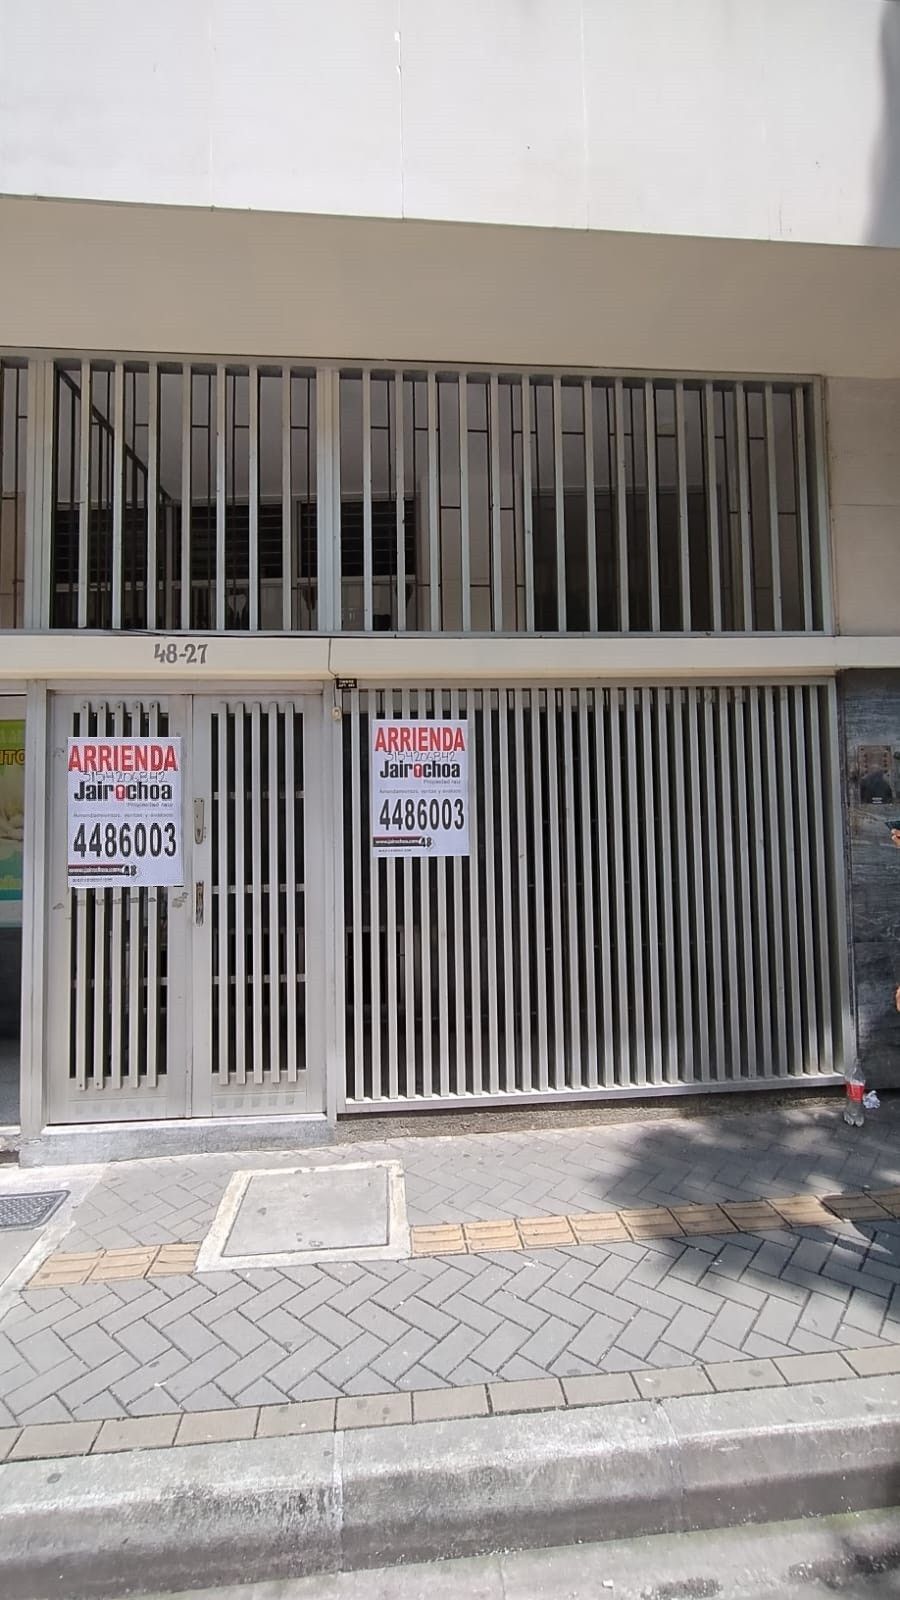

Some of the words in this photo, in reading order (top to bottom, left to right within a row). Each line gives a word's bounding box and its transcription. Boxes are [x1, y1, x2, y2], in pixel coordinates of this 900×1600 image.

[154, 643, 209, 664] 48-27
[375, 727, 466, 752] ARRIENDA
[69, 745, 179, 772] ARRIENDA
[380, 799, 465, 830] 4486003
[73, 822, 177, 858] 4486003
